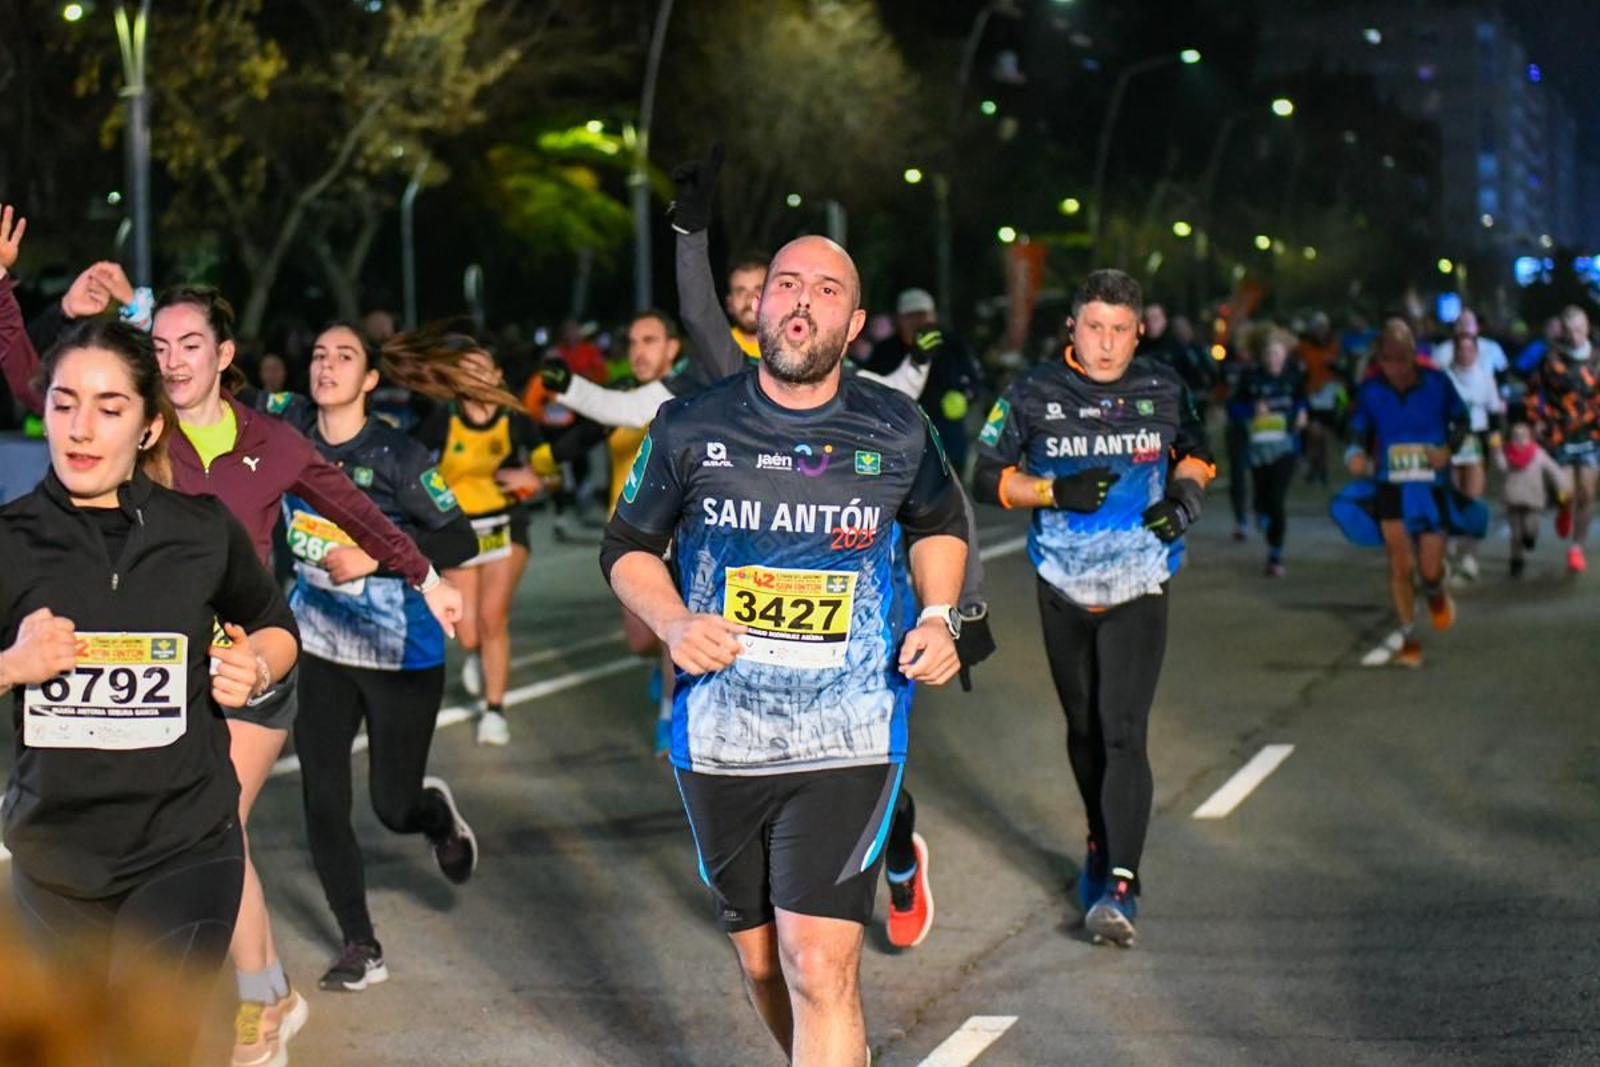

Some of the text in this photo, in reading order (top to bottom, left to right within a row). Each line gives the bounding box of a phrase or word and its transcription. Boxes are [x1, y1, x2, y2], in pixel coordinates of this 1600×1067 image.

[1046, 428, 1161, 457] SAN ANTÓN
[756, 452, 792, 468] jaén
[703, 497, 880, 534] SAN ANTÓN
[831, 527, 875, 550] 2025
[734, 590, 842, 630] 3427
[41, 667, 170, 704] 6792
